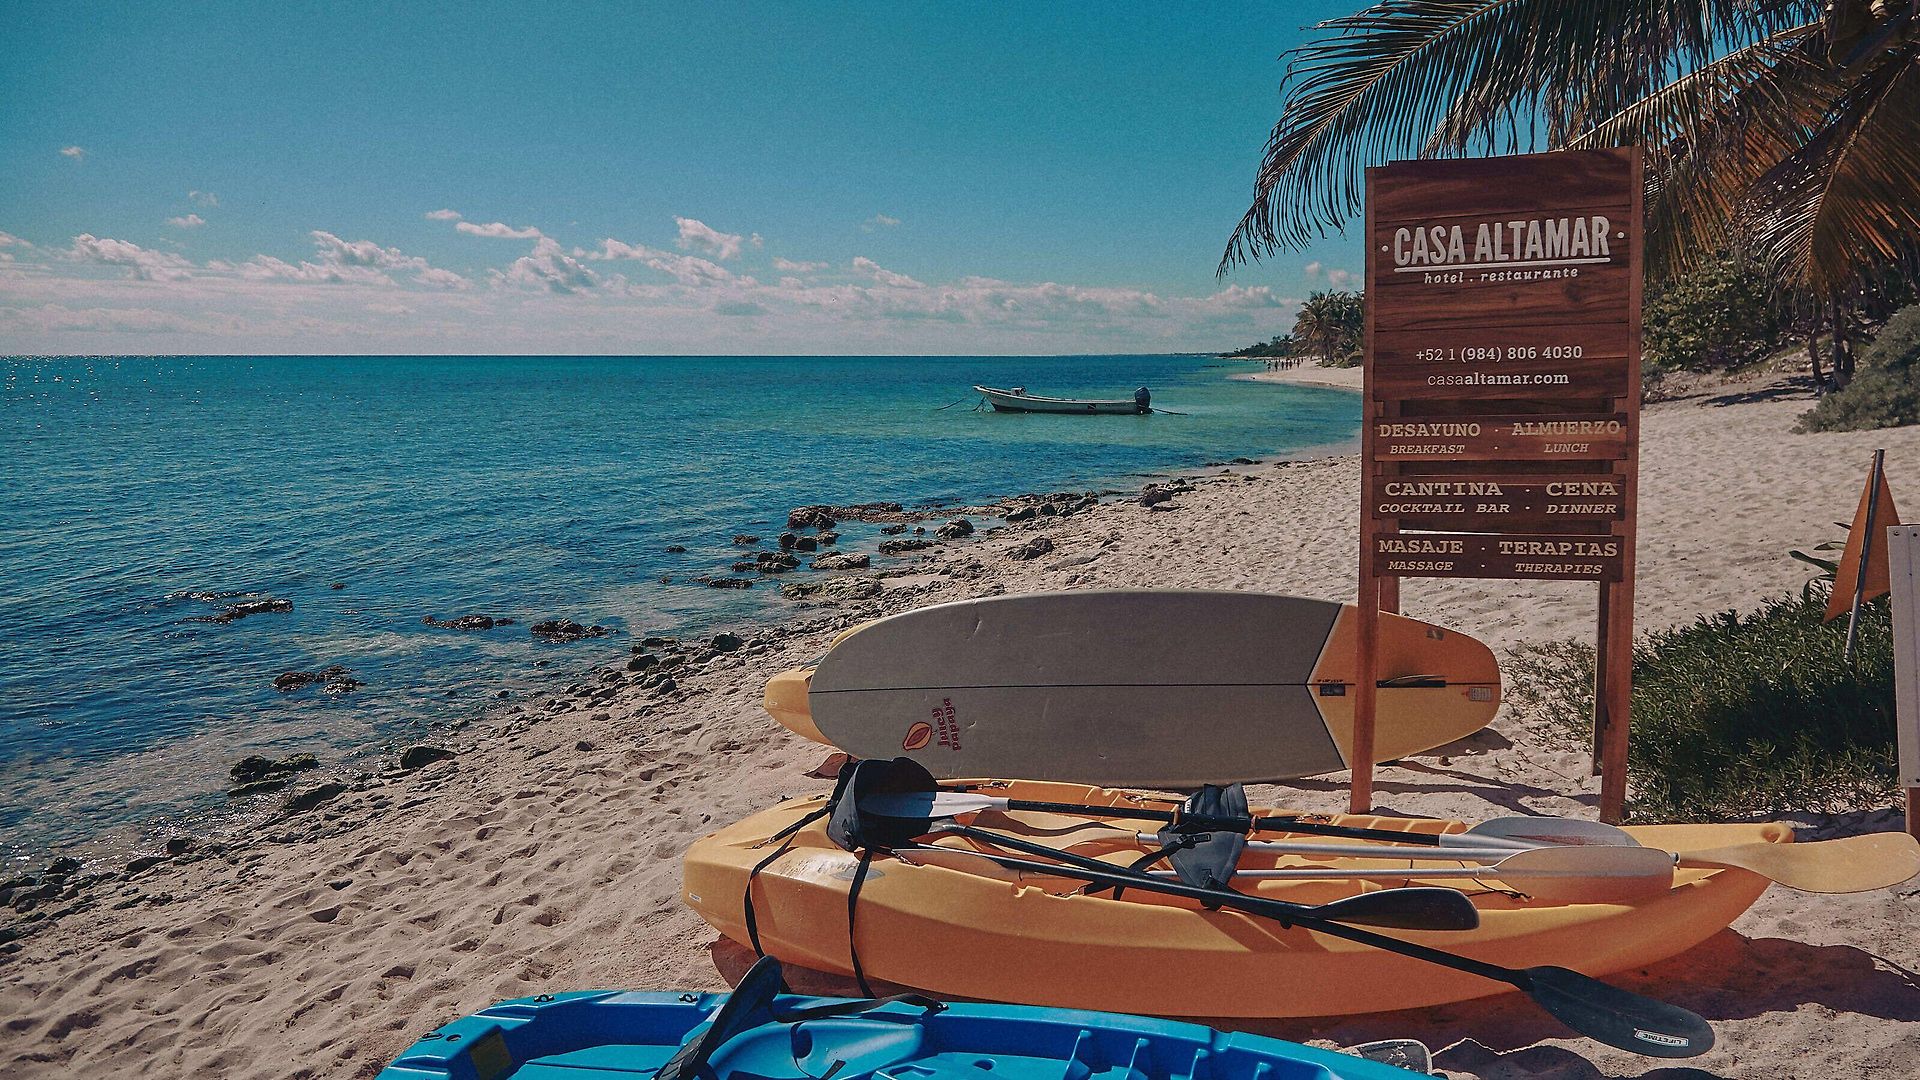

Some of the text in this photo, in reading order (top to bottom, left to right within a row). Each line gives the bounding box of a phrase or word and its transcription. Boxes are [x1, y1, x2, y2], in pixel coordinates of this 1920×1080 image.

[1394, 216, 1611, 266] CASA ALTAMAR
[1424, 267, 1579, 285] hotel restaurante
[1415, 345, 1583, 363] +52 1 (984) 806 4030
[1427, 371, 1570, 386] casaaltamar.com
[1379, 420, 1621, 438] DESAYUNO ALMUERZO
[1390, 443, 1590, 455] BREAKFAST LUNCH
[1385, 482, 1618, 497] CANTINA CENA
[1378, 503, 1618, 515] COCKTAIL BAR DINNER
[1378, 539, 1618, 557] MASAJE TERAPIAS
[1387, 561, 1603, 574] MASSAGE THERAPIES
[1642, 1033, 1682, 1045] LIFETIME
